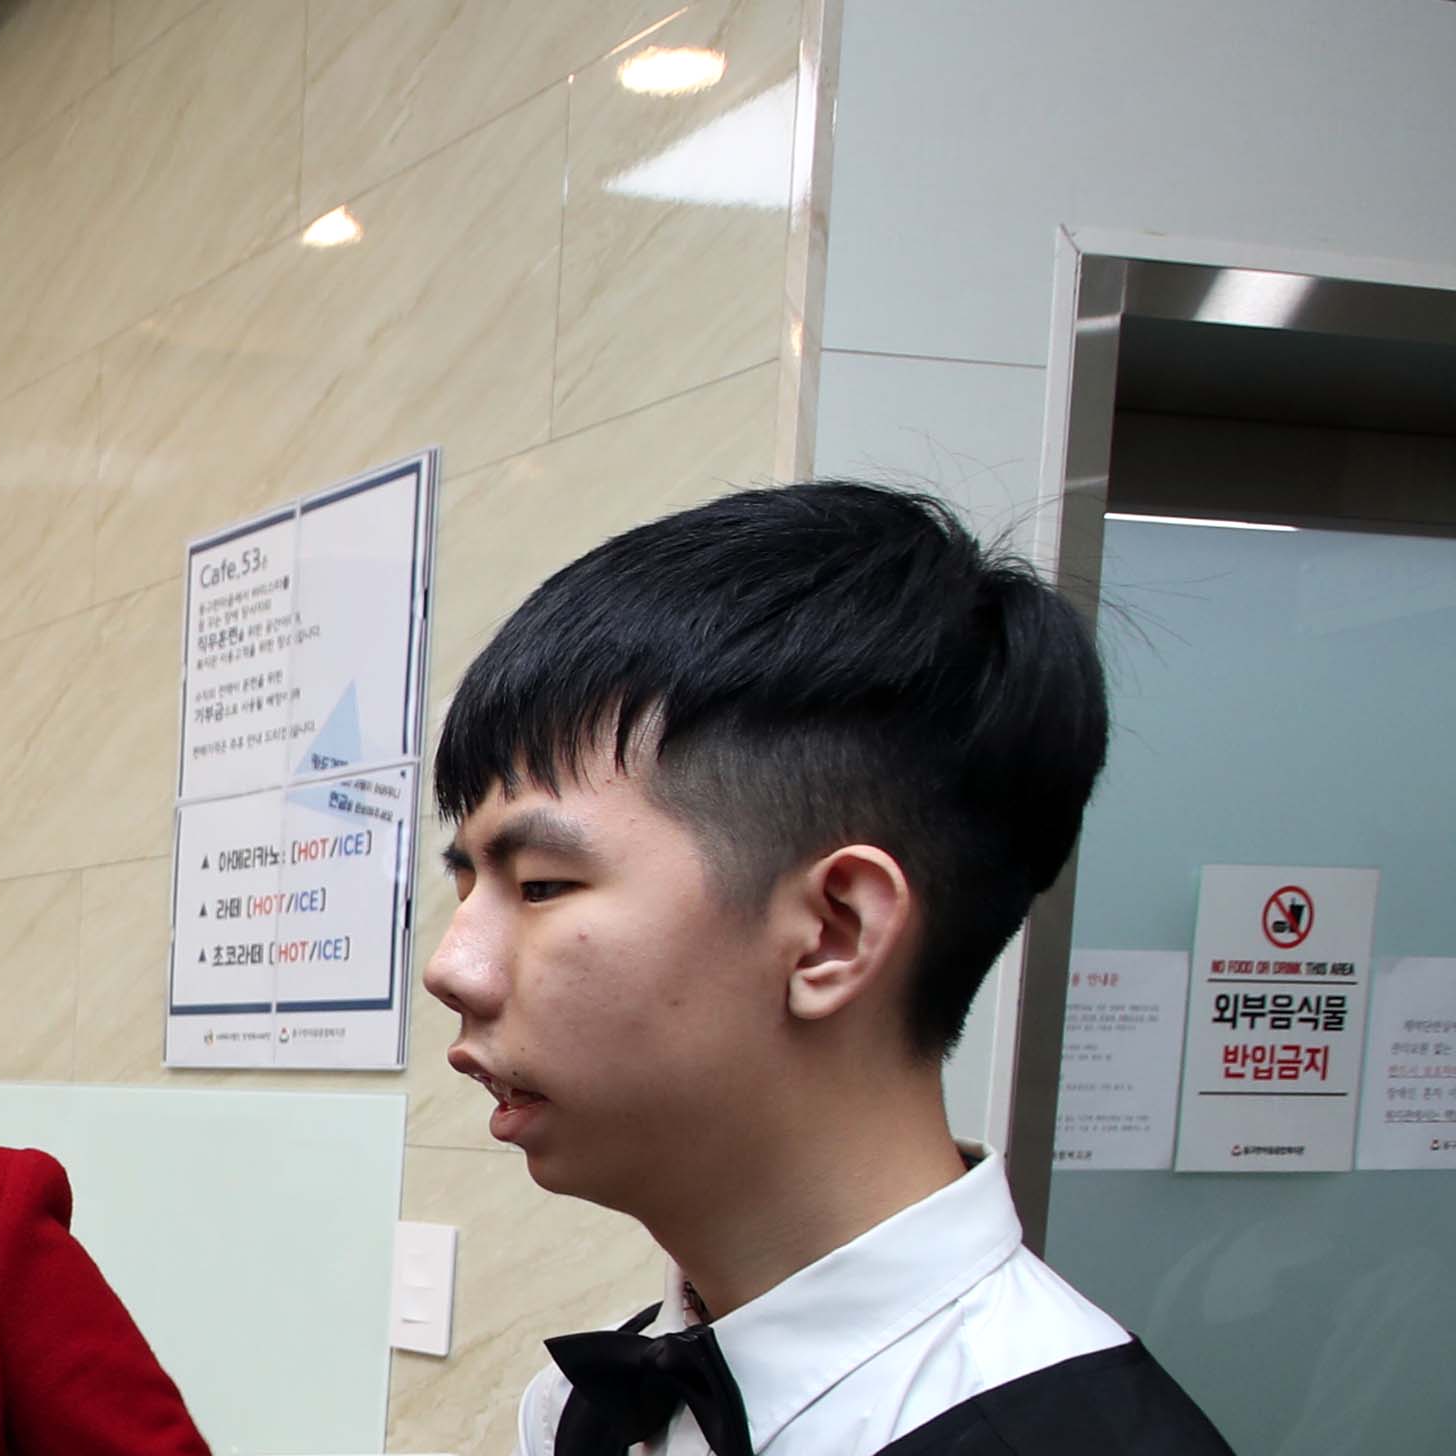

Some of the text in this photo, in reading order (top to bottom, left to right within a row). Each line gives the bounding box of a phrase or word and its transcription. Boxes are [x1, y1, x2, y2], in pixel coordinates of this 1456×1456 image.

[1330, 962, 1355, 976] AREA
[1212, 993, 1348, 1032] 외부음식물
[1222, 1044, 1330, 1081] 반입금지
